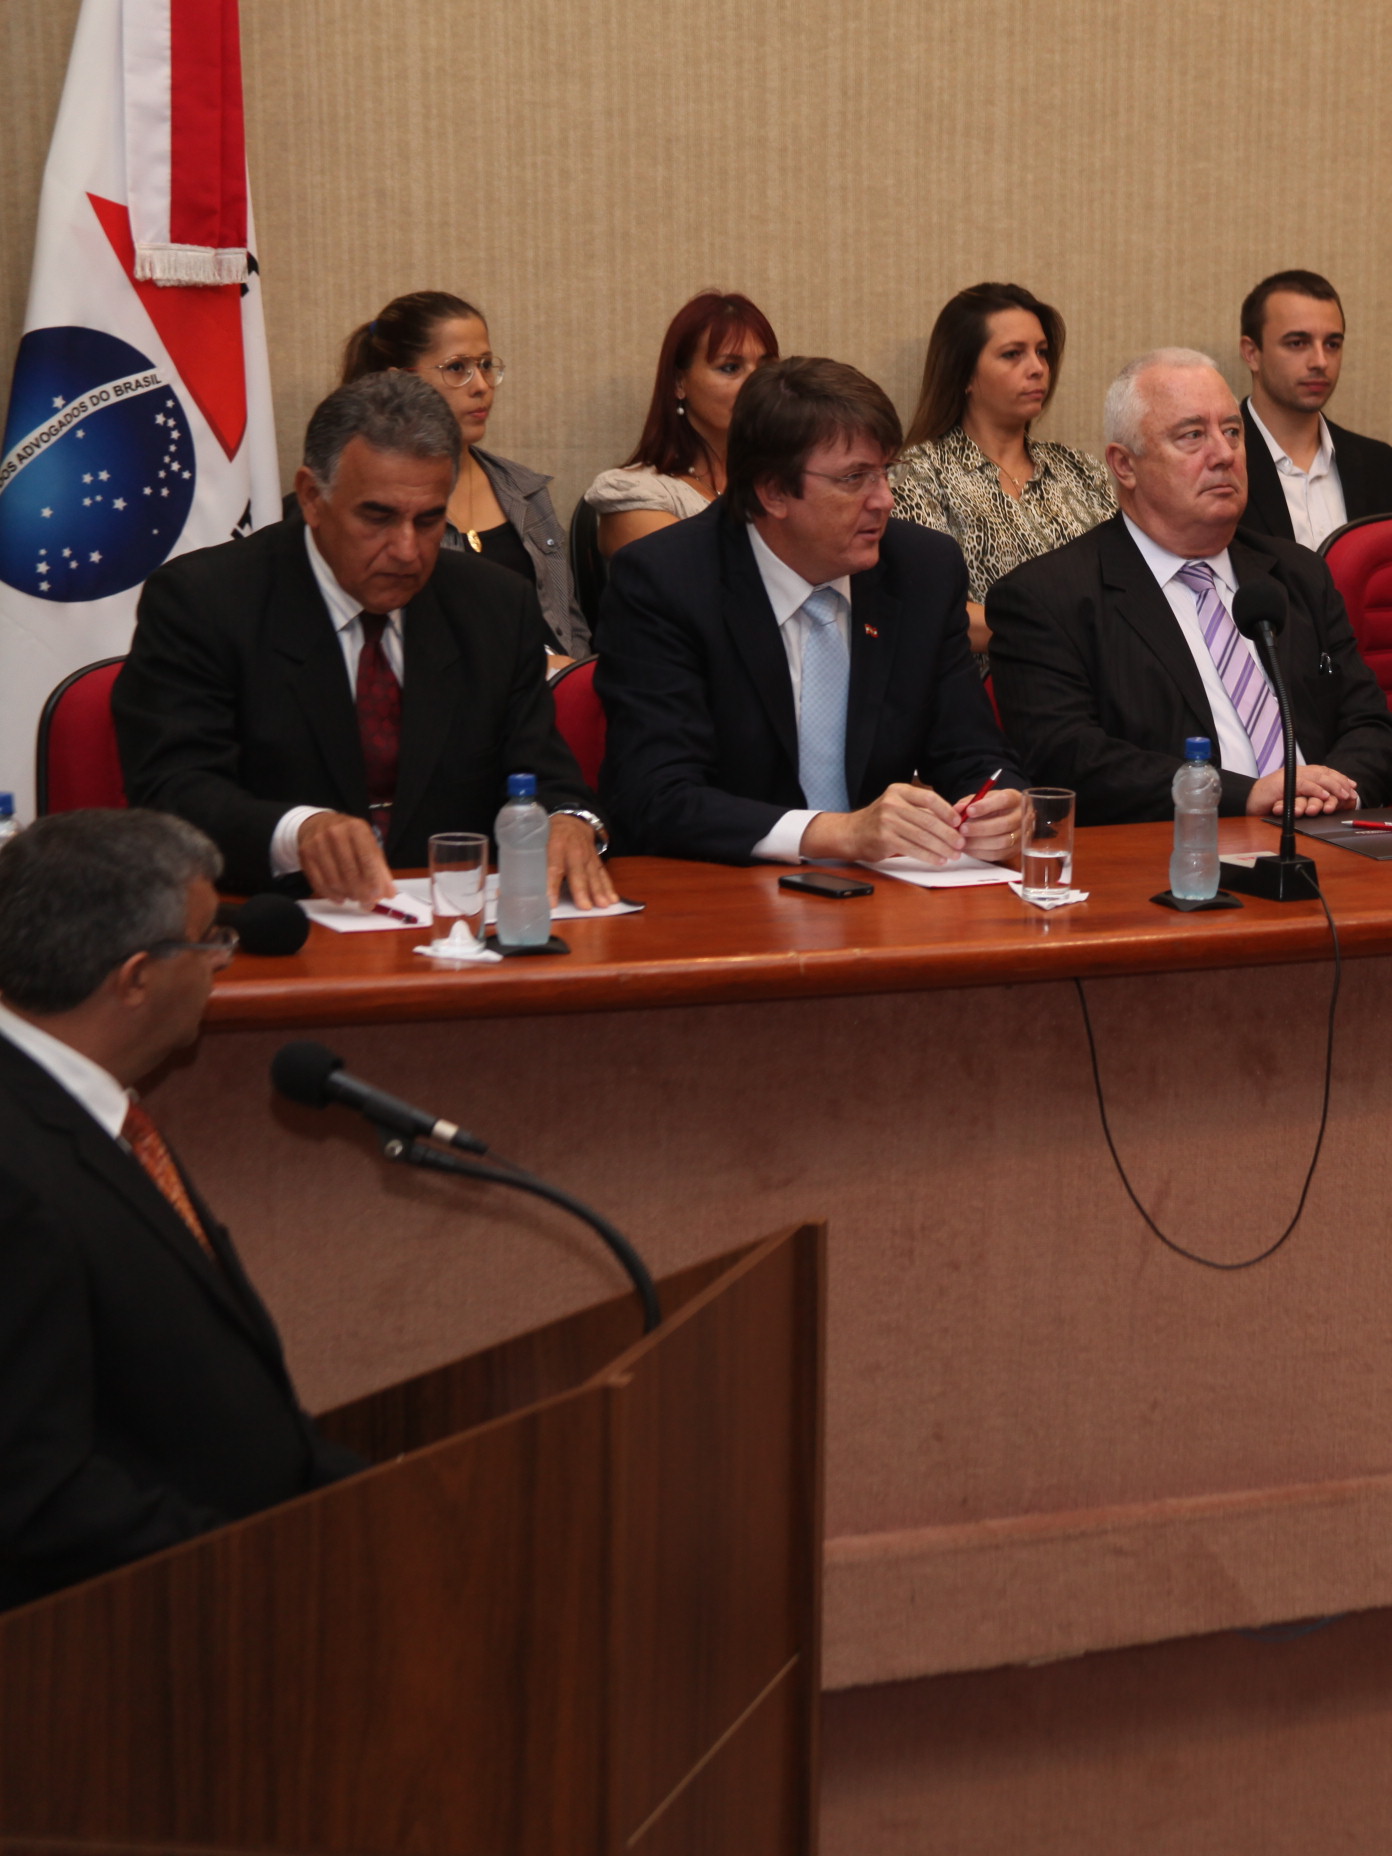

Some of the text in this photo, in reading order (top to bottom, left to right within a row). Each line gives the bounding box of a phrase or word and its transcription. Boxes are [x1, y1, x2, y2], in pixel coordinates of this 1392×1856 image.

[16, 401, 89, 465] ADVOGADOS
[89, 390, 111, 407] DO
[112, 374, 162, 398] BRASIL
